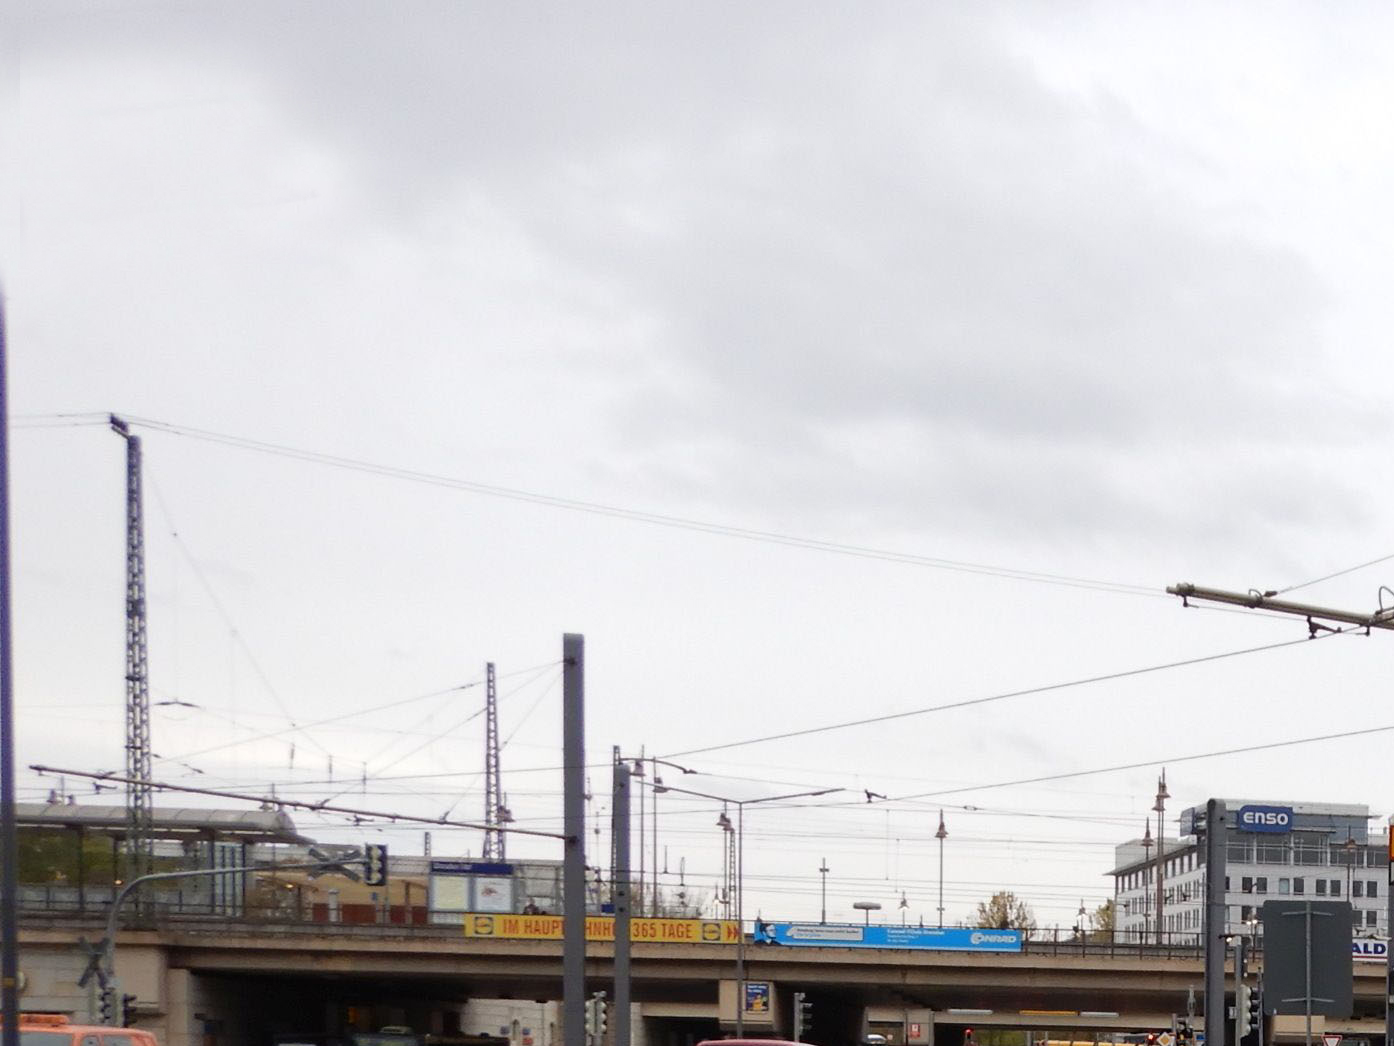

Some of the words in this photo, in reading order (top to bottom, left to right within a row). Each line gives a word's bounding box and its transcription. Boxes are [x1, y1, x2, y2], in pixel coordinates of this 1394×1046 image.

[503, 919, 519, 934] IM
[633, 922, 657, 937] 365
[662, 923, 693, 938] TAGE
